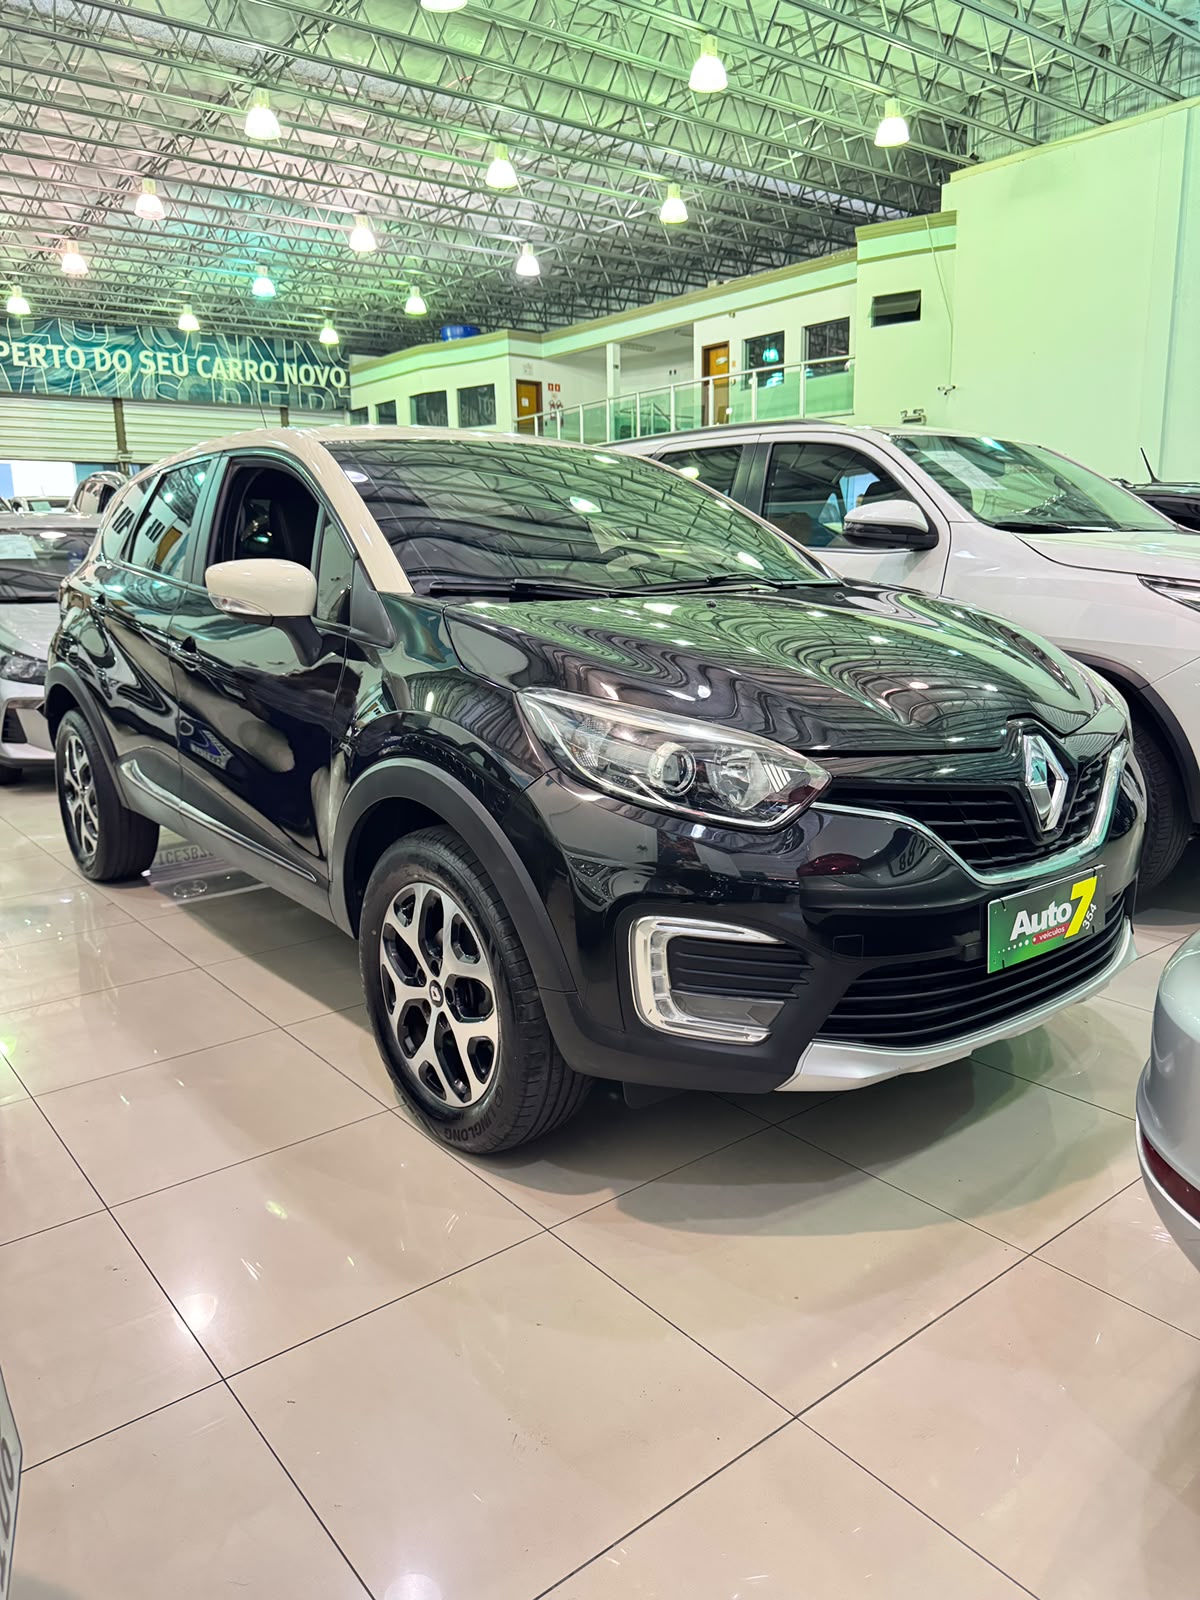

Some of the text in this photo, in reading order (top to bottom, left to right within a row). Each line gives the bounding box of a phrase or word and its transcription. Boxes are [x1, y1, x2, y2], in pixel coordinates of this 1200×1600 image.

[94, 349, 133, 373] DO
[139, 350, 189, 377] SEU
[196, 354, 277, 383] CARRO
[283, 362, 347, 388] NOVO
[1009, 901, 1072, 941] Auto
[1082, 903, 1098, 930] 354
[444, 1104, 497, 1142] LINGLONG
